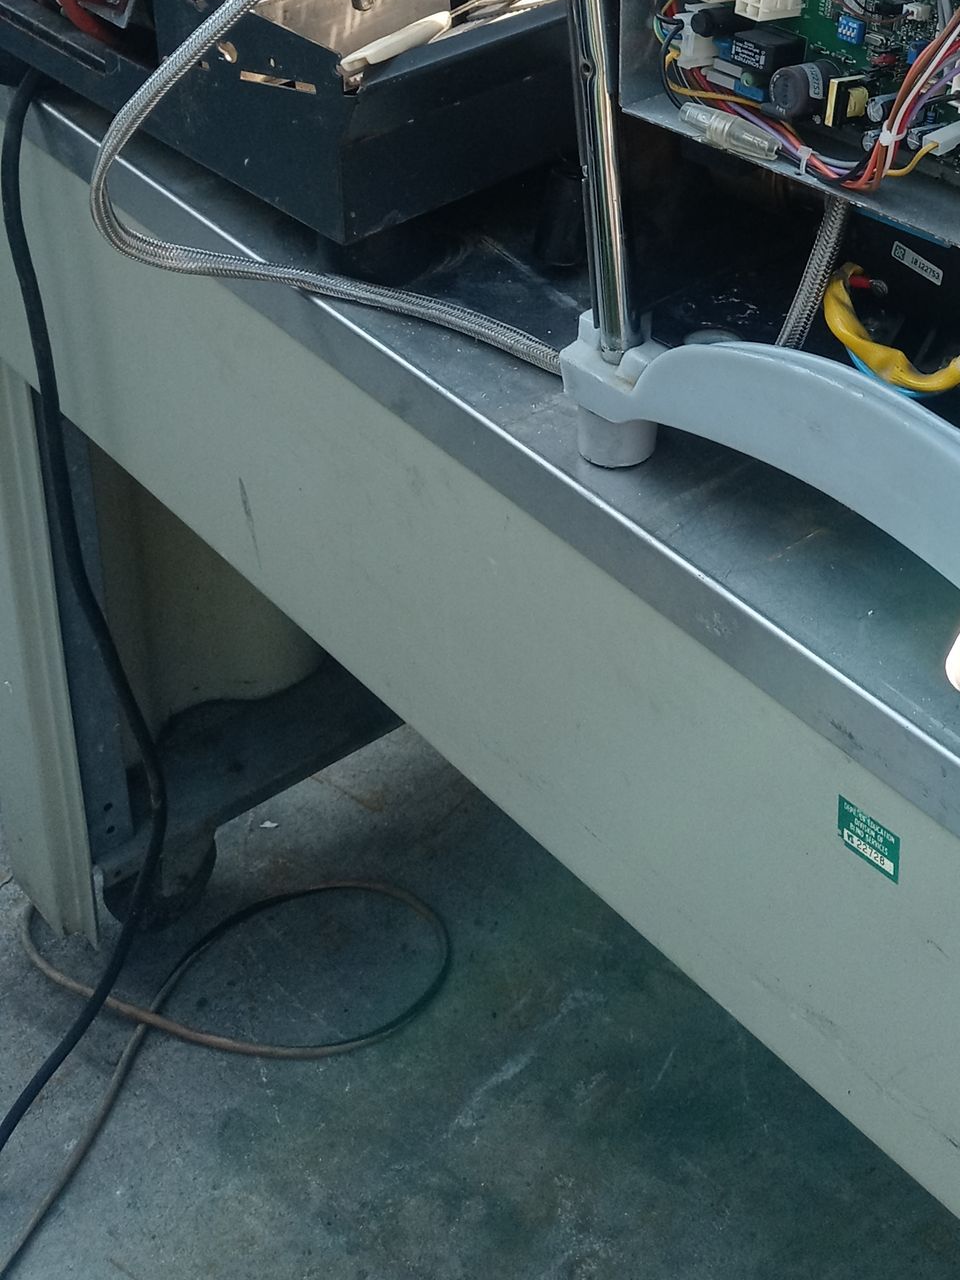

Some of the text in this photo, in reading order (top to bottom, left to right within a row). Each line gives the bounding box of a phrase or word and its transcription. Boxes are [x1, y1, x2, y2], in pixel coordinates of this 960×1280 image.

[849, 822, 888, 856] BLIND SERVICES
[854, 817, 884, 843] DIVISION OF
[867, 818, 895, 845] EDUCATION
[856, 838, 885, 867] 22728
